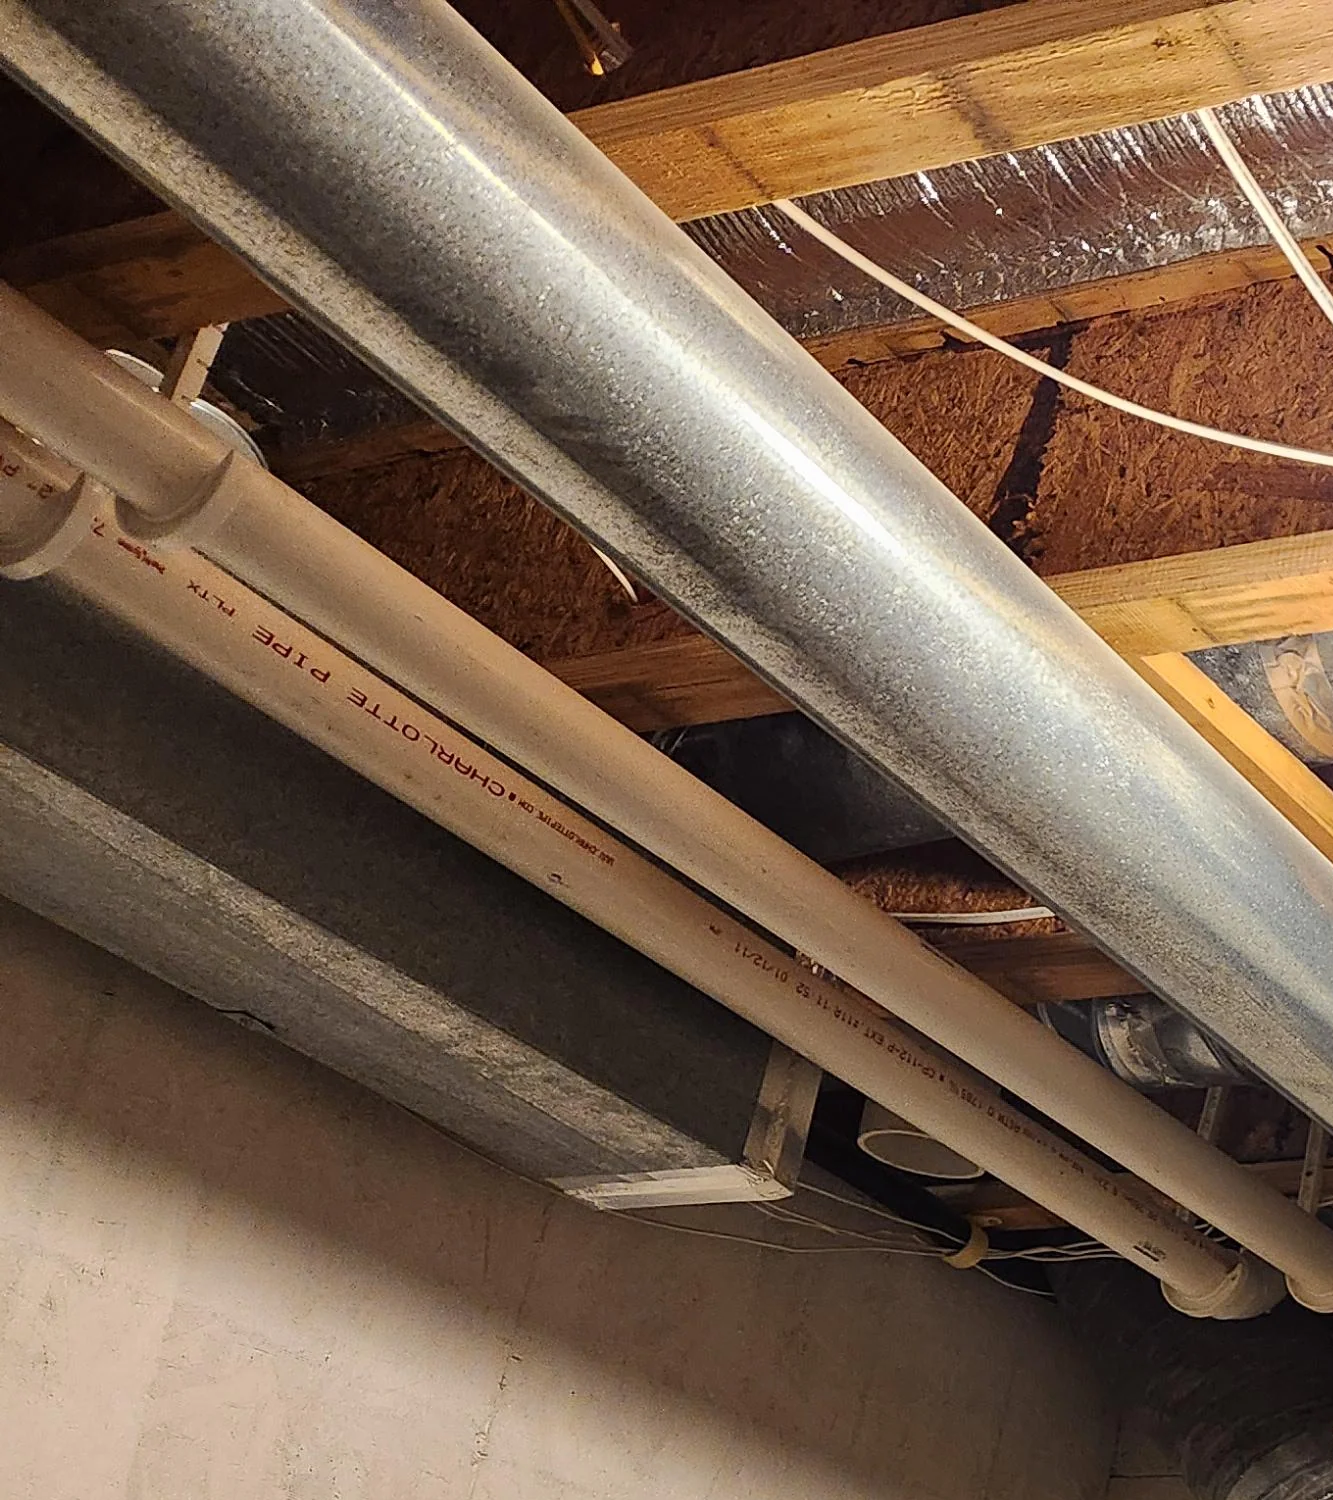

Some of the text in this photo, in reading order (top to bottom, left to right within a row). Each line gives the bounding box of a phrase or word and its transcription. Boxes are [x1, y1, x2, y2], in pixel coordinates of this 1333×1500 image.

[183, 578, 237, 619] PLTX
[250, 622, 334, 685] PIPE
[344, 684, 509, 800] CHARLOTTE
